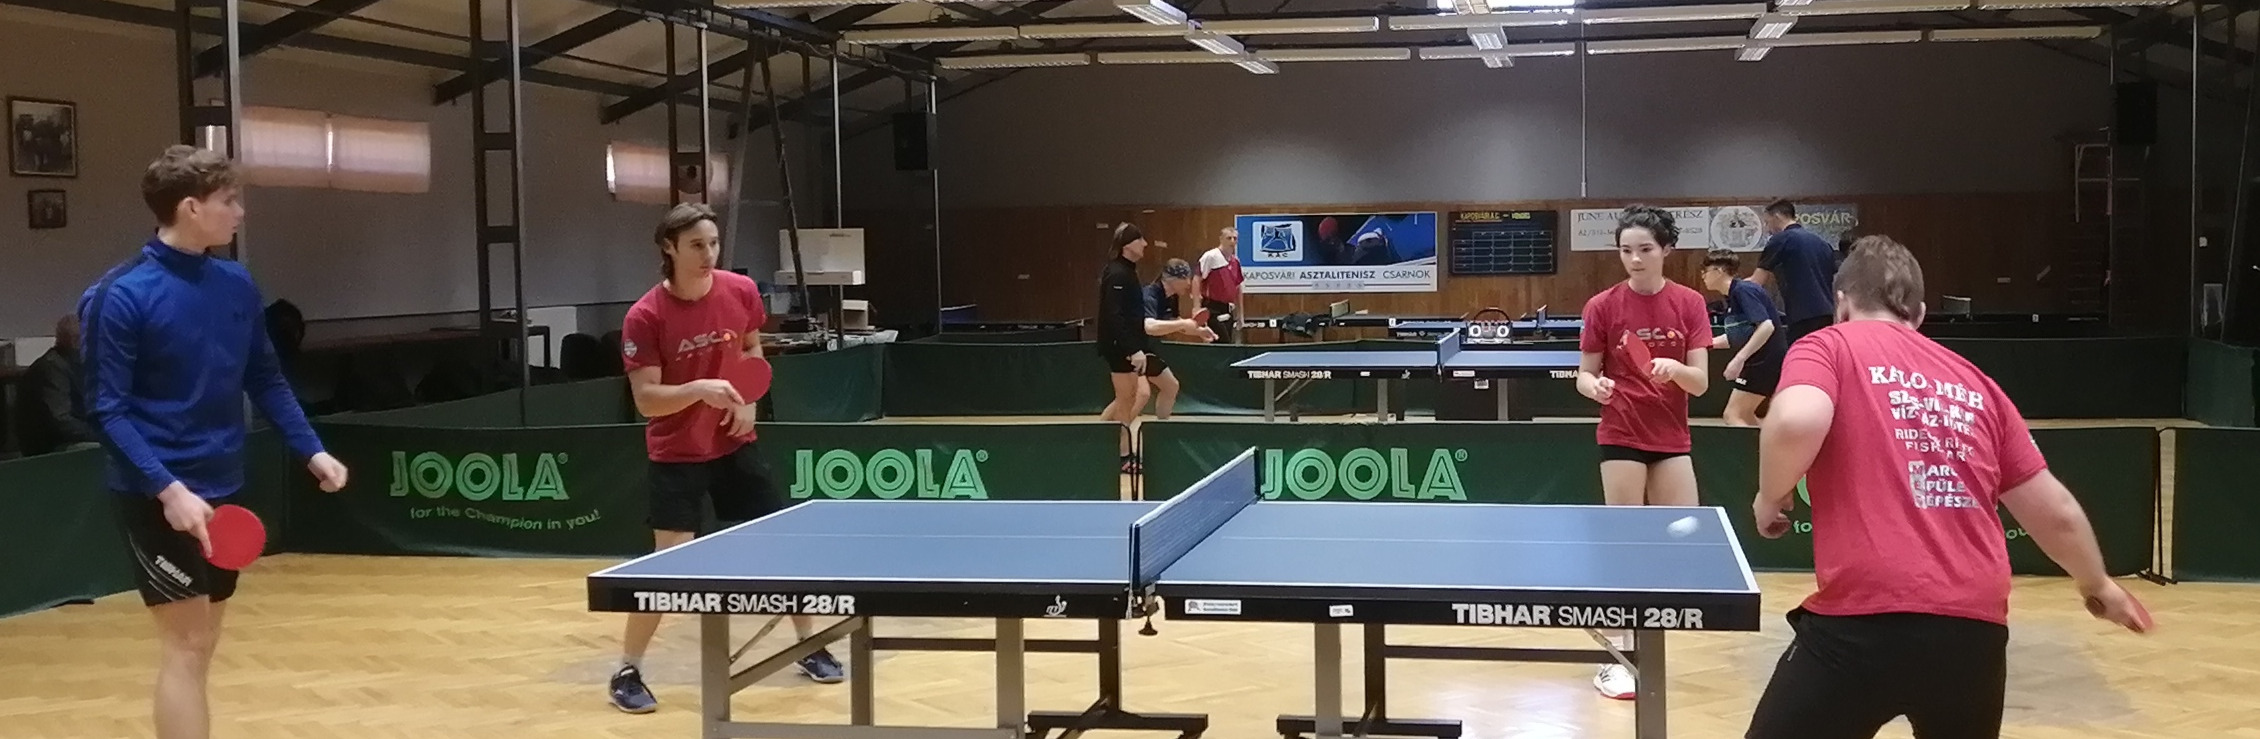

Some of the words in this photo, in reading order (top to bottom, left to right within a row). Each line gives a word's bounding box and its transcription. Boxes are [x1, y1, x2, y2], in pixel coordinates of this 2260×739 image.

[1299, 270, 1376, 280] ASZTALITENISZ
[1382, 270, 1431, 279] CSARNOK
[1549, 370, 1579, 379] TIBHA
[390, 451, 570, 501] JOOLA
[789, 449, 989, 500] JOOLA
[1260, 447, 1468, 500] JOOLA
[410, 507, 432, 519] for
[436, 505, 461, 517] the
[464, 506, 543, 530] Champion
[547, 517, 562, 530] in
[565, 508, 602, 531] you!
[1792, 520, 1813, 535] fo
[633, 591, 723, 613] TIBHAR
[726, 593, 798, 613] SMASH
[801, 595, 856, 615] 28/R
[1451, 603, 1552, 625] TIBHAR
[1557, 605, 1638, 627] SMASH
[1643, 607, 1704, 629] 28/R
